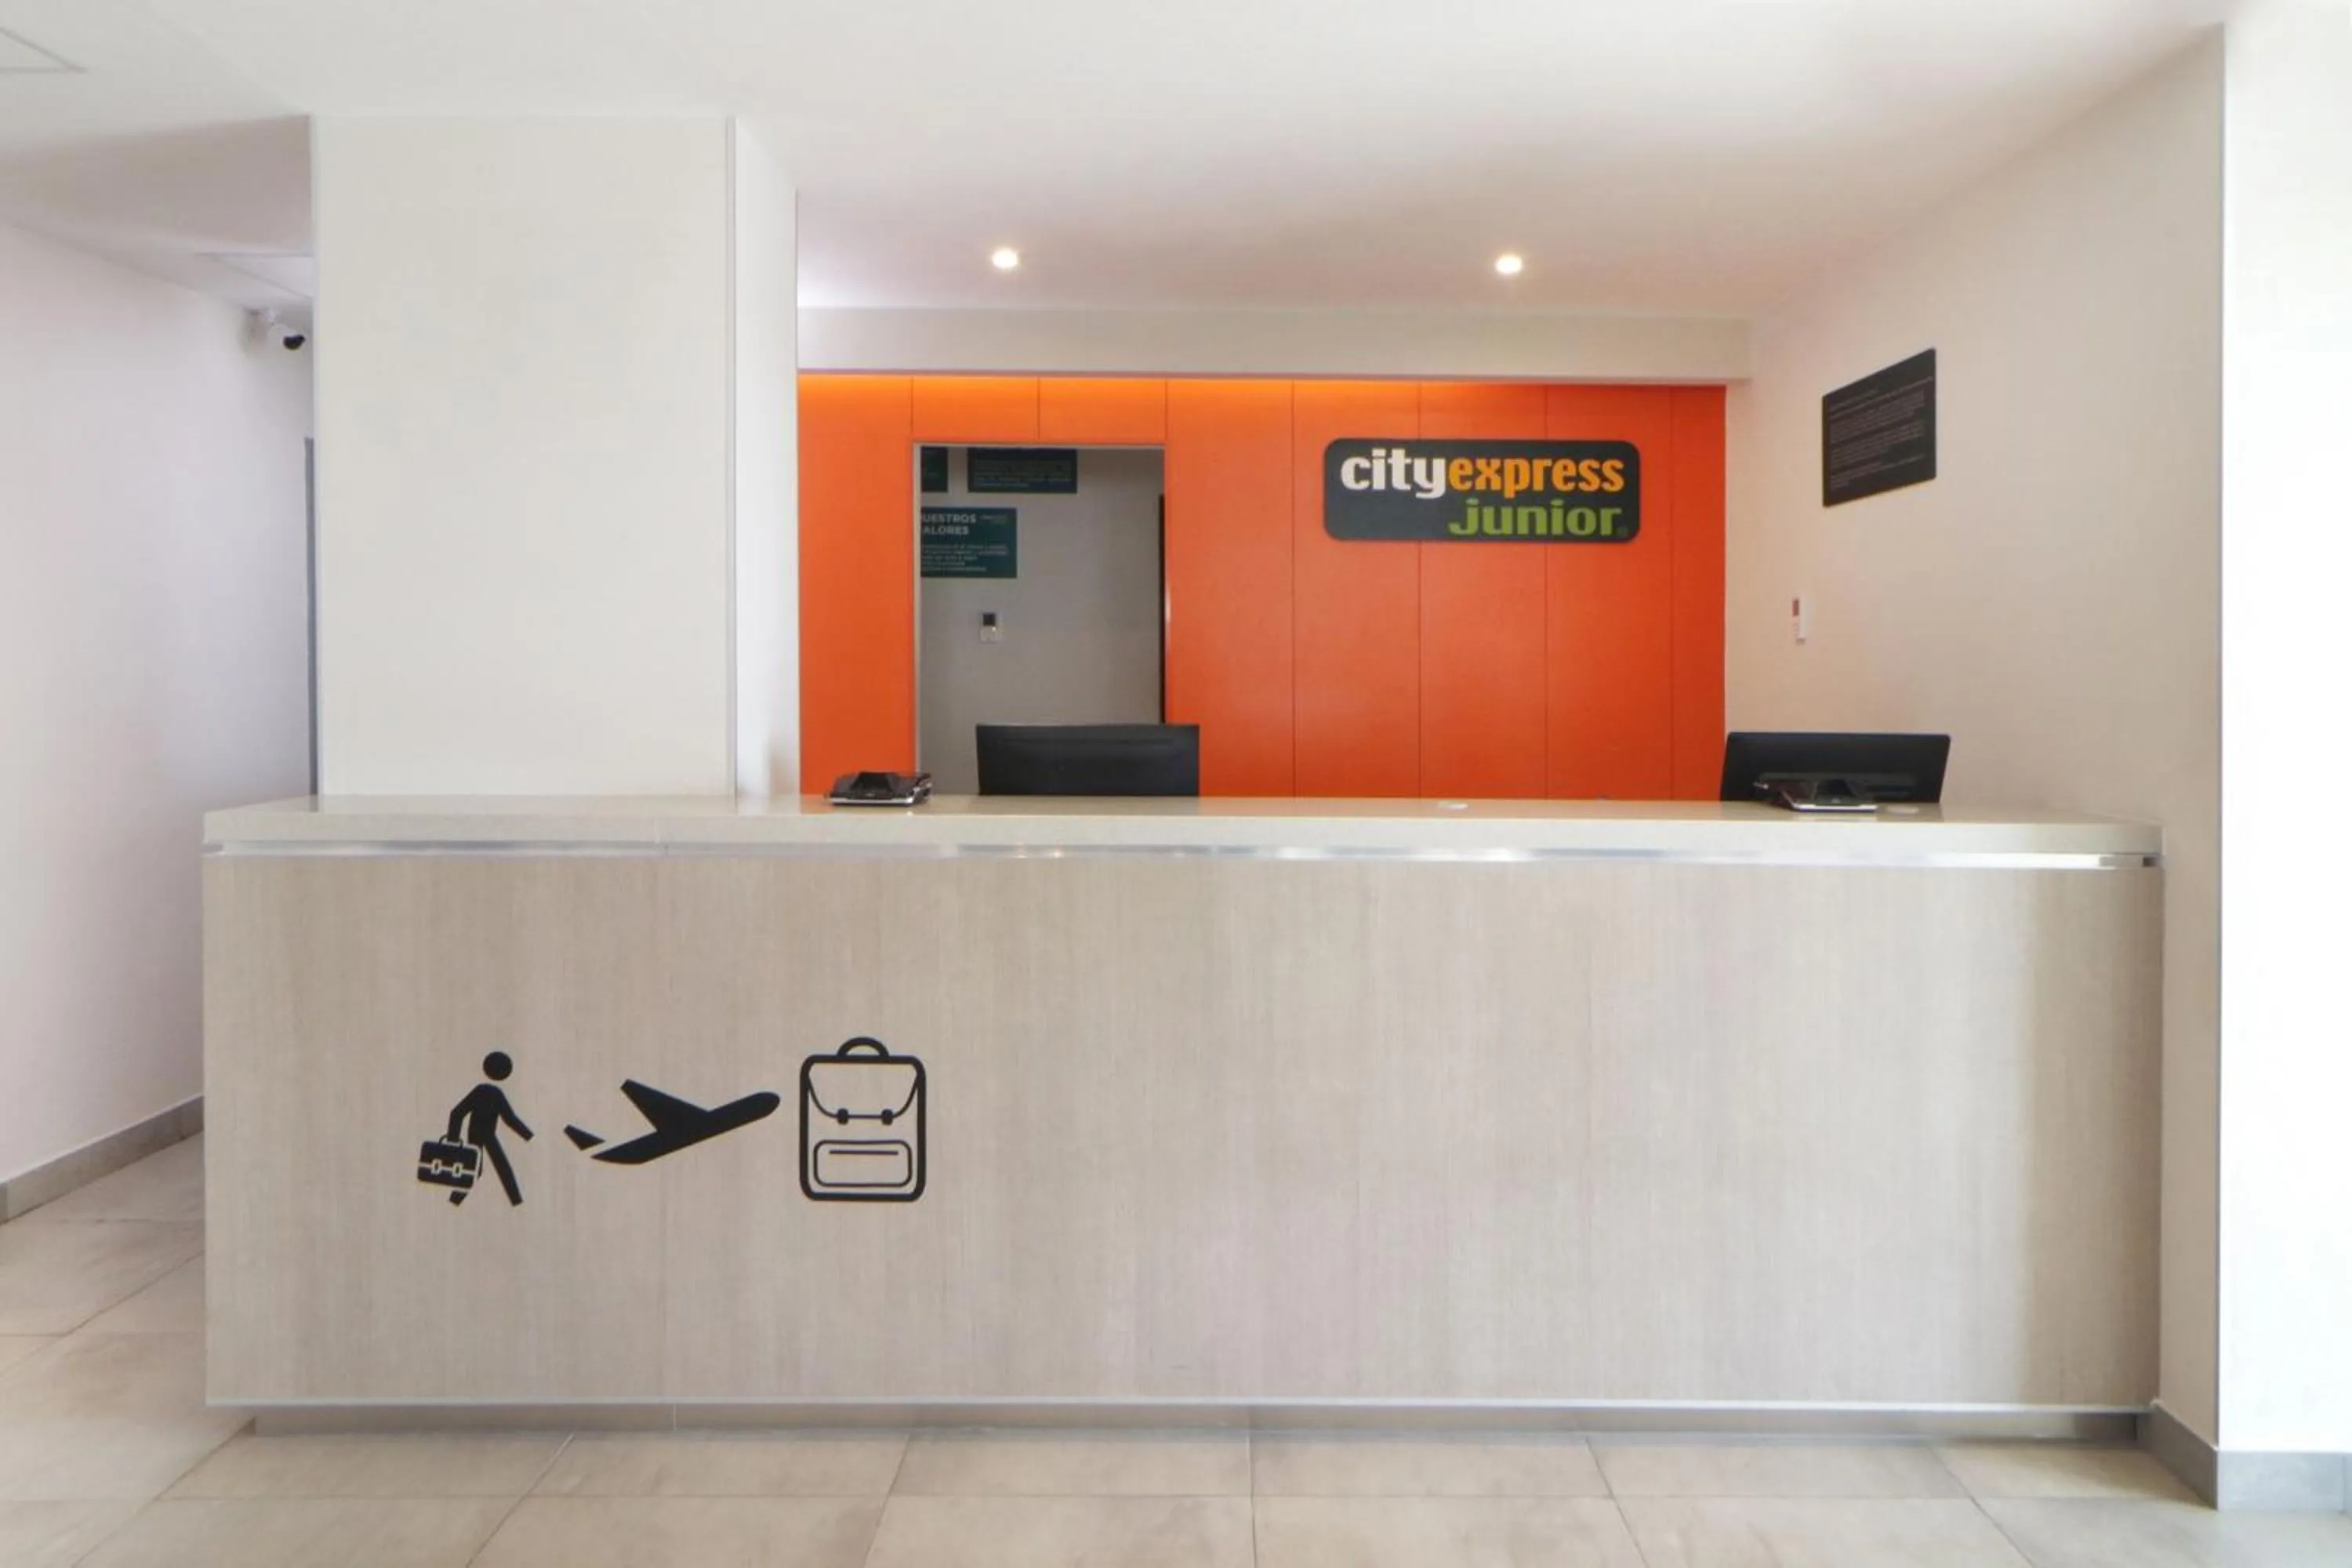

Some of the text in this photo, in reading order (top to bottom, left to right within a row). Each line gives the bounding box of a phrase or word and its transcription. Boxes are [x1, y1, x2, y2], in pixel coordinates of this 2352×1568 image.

[922, 514, 976, 524] UESTROS
[1448, 499, 1622, 536] junior
[922, 525, 969, 535] ALORES
